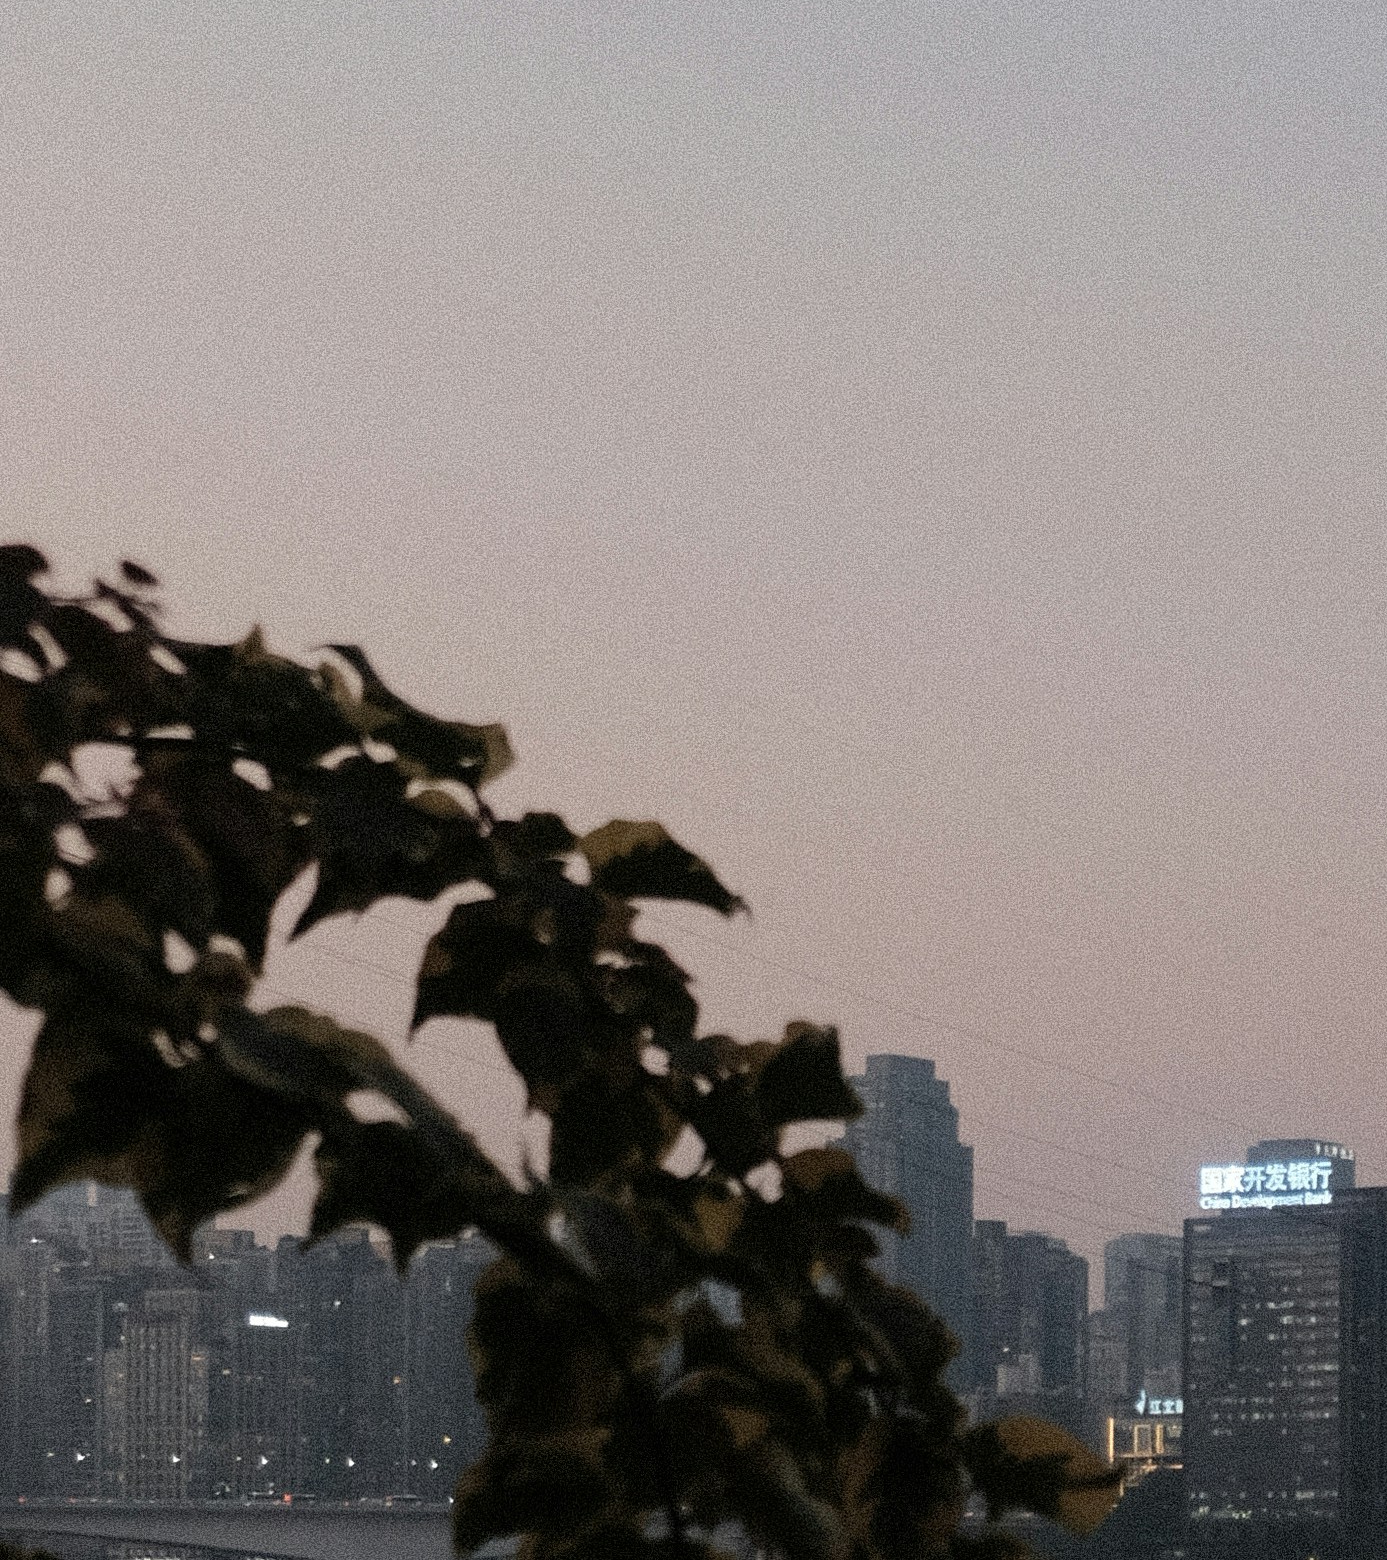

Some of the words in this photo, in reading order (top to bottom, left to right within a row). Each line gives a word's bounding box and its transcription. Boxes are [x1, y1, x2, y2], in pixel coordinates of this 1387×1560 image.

[1201, 1161, 1332, 1194] 国家开发银行
